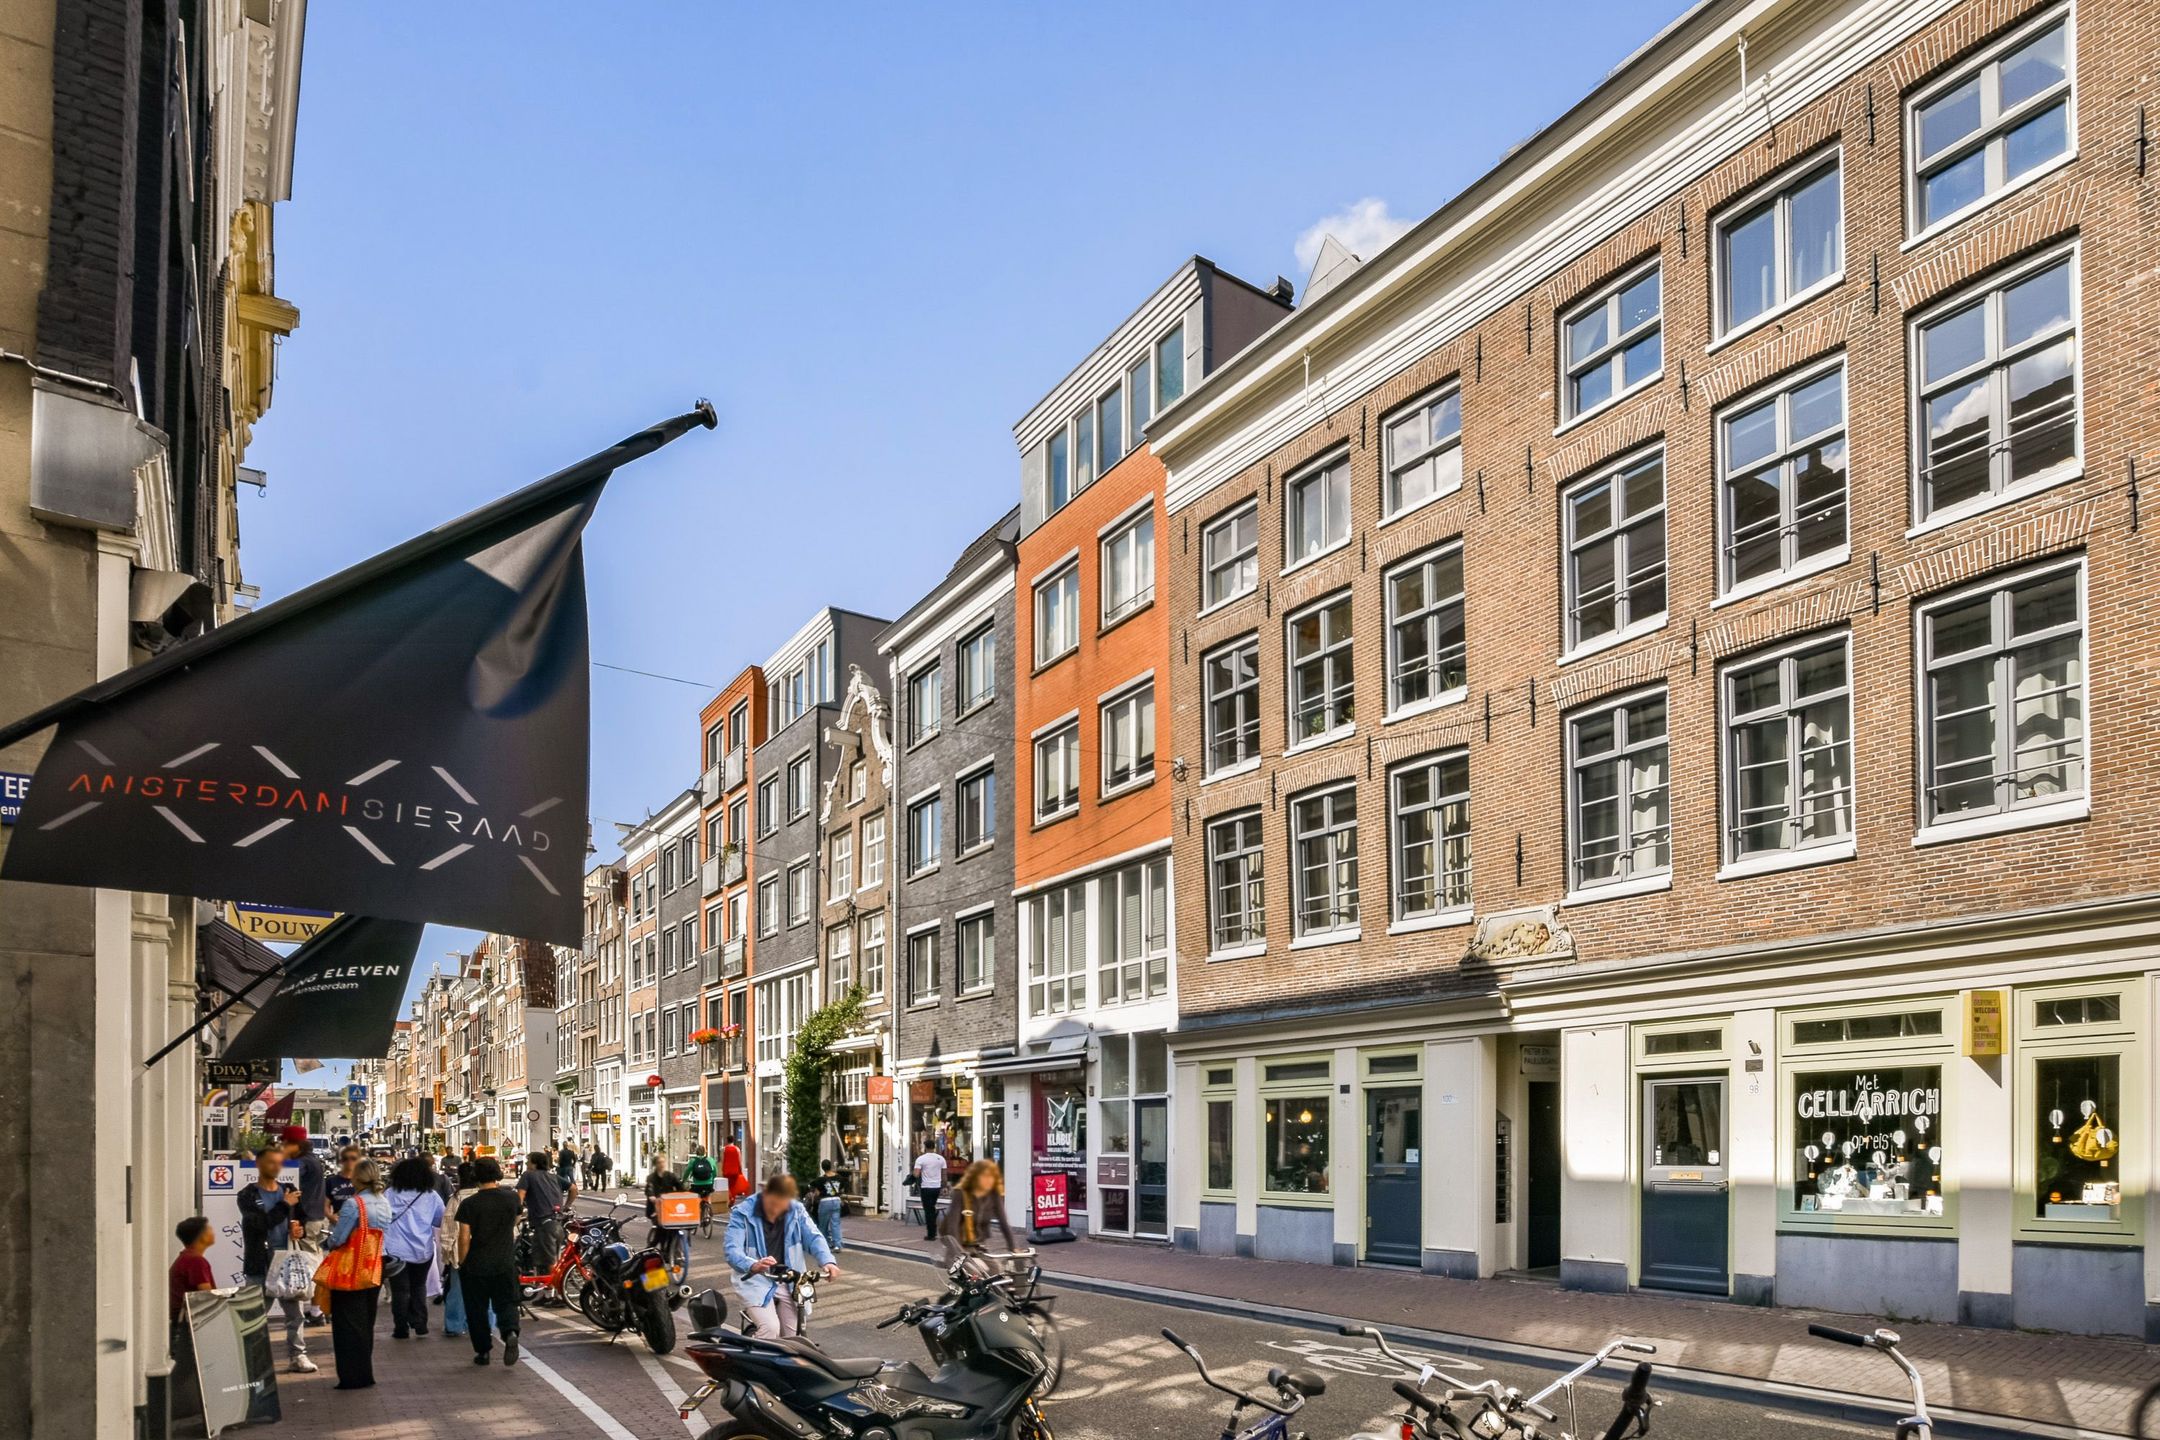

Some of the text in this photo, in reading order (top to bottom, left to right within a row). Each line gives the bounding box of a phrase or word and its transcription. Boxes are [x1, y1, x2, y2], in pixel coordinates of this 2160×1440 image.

[249, 916, 320, 937] POUW
[323, 964, 401, 979] ELEVEN
[213, 1065, 248, 1076] DIVA
[1855, 1074, 1880, 1091] Met
[1798, 1088, 1939, 1118] CELLARRICH
[1047, 1132, 1072, 1146] KLABU
[1037, 1194, 1064, 1208] SALE
